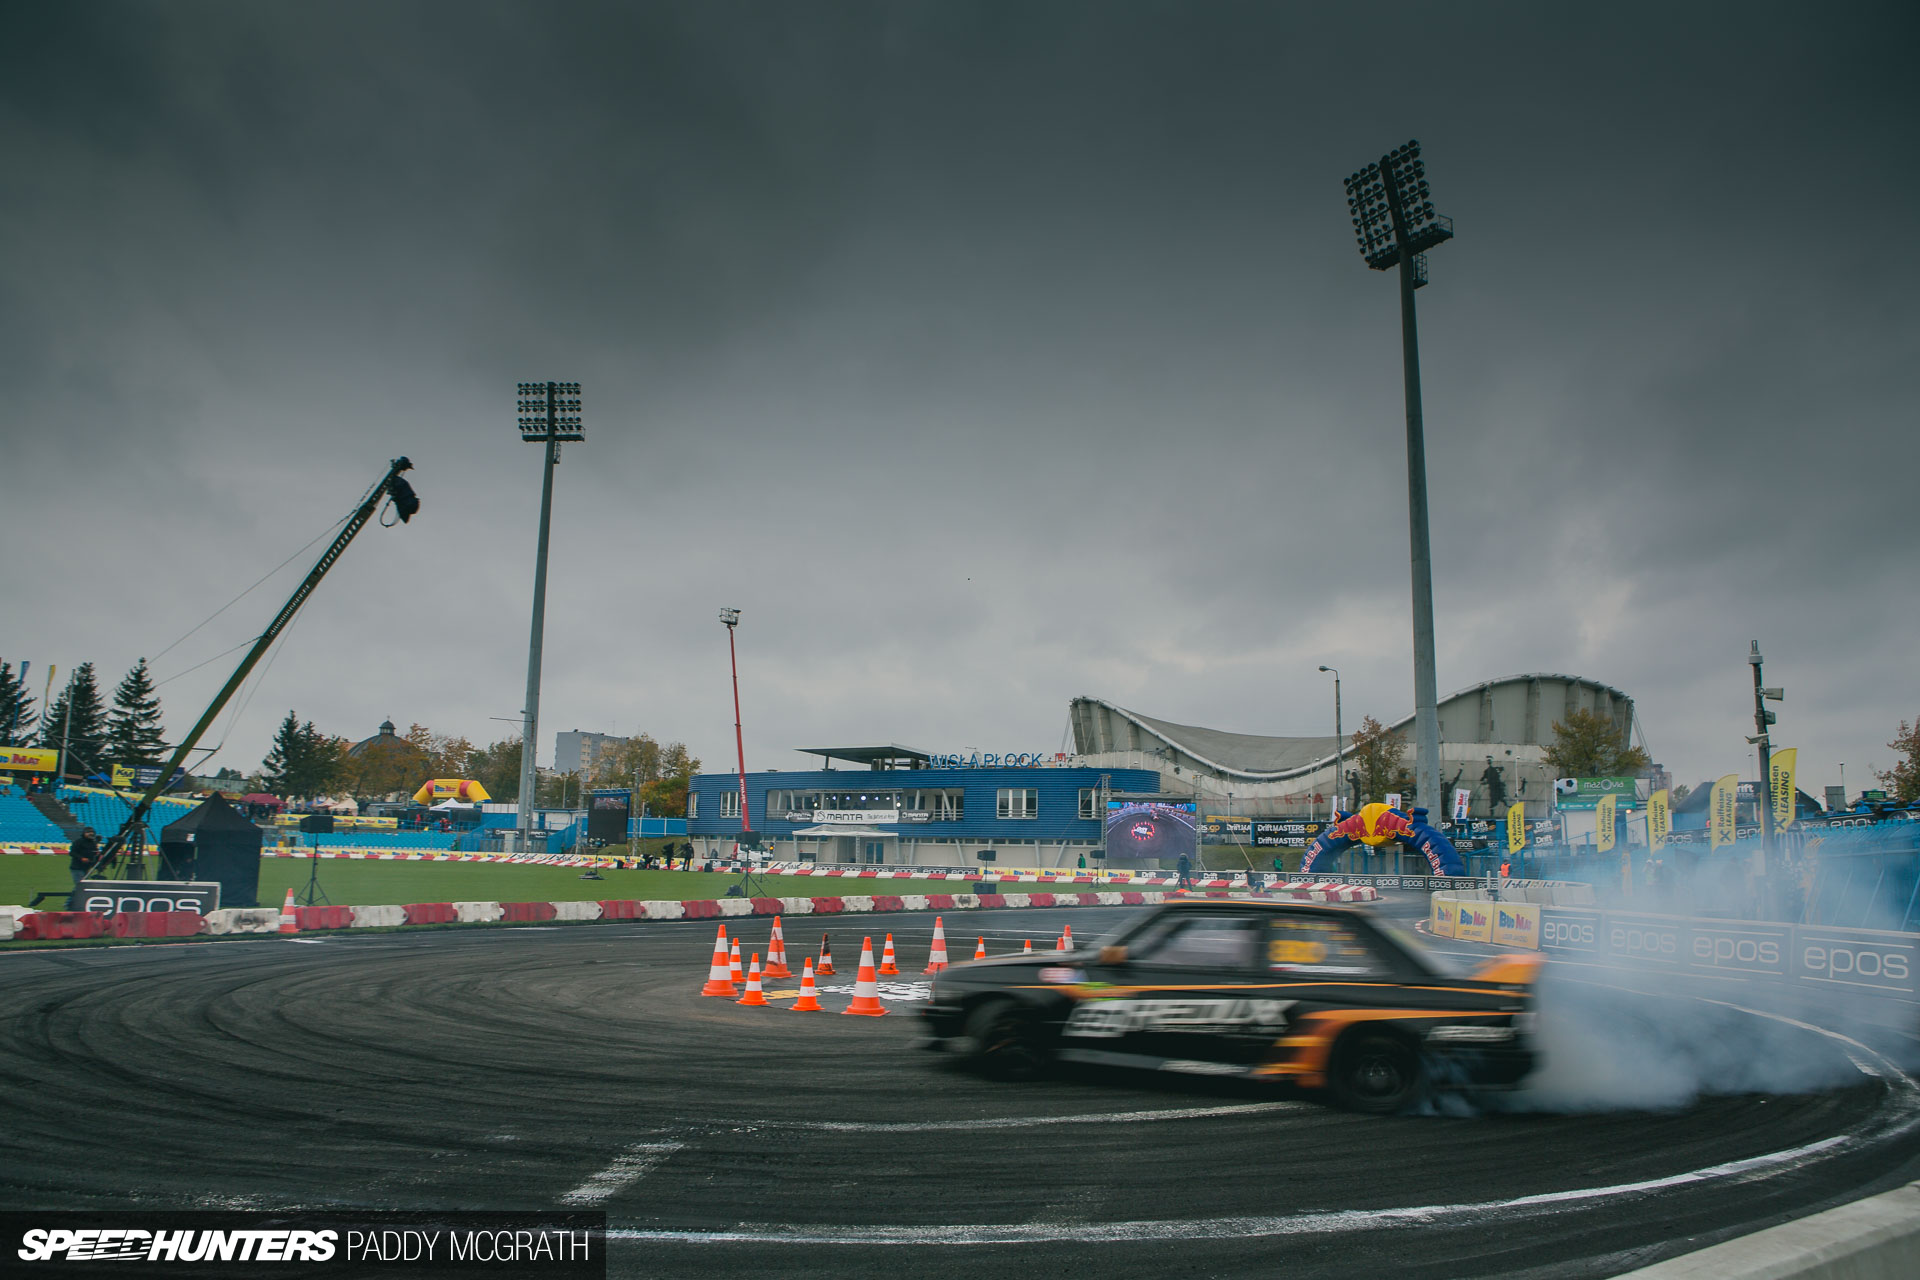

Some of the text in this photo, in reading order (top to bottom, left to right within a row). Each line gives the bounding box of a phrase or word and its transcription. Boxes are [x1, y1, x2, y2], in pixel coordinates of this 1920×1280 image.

[927, 752, 1044, 769] WISŁA PŁOCK
[1771, 765, 1779, 813] aiffeisen
[1780, 771, 1790, 814] LEASING
[1658, 804, 1666, 833] LEASING
[1348, 877, 1372, 887] epos
[1376, 878, 1399, 887] epos
[1402, 879, 1424, 888] epos
[1429, 879, 1451, 889] epos
[1454, 880, 1476, 889] epos
[1459, 908, 1487, 927] BUD MAT
[1499, 910, 1532, 931] BUD MAT
[1543, 922, 1594, 945] epos
[1610, 928, 1676, 955] epos
[1693, 935, 1780, 965] epos
[1803, 945, 1910, 979] epos
